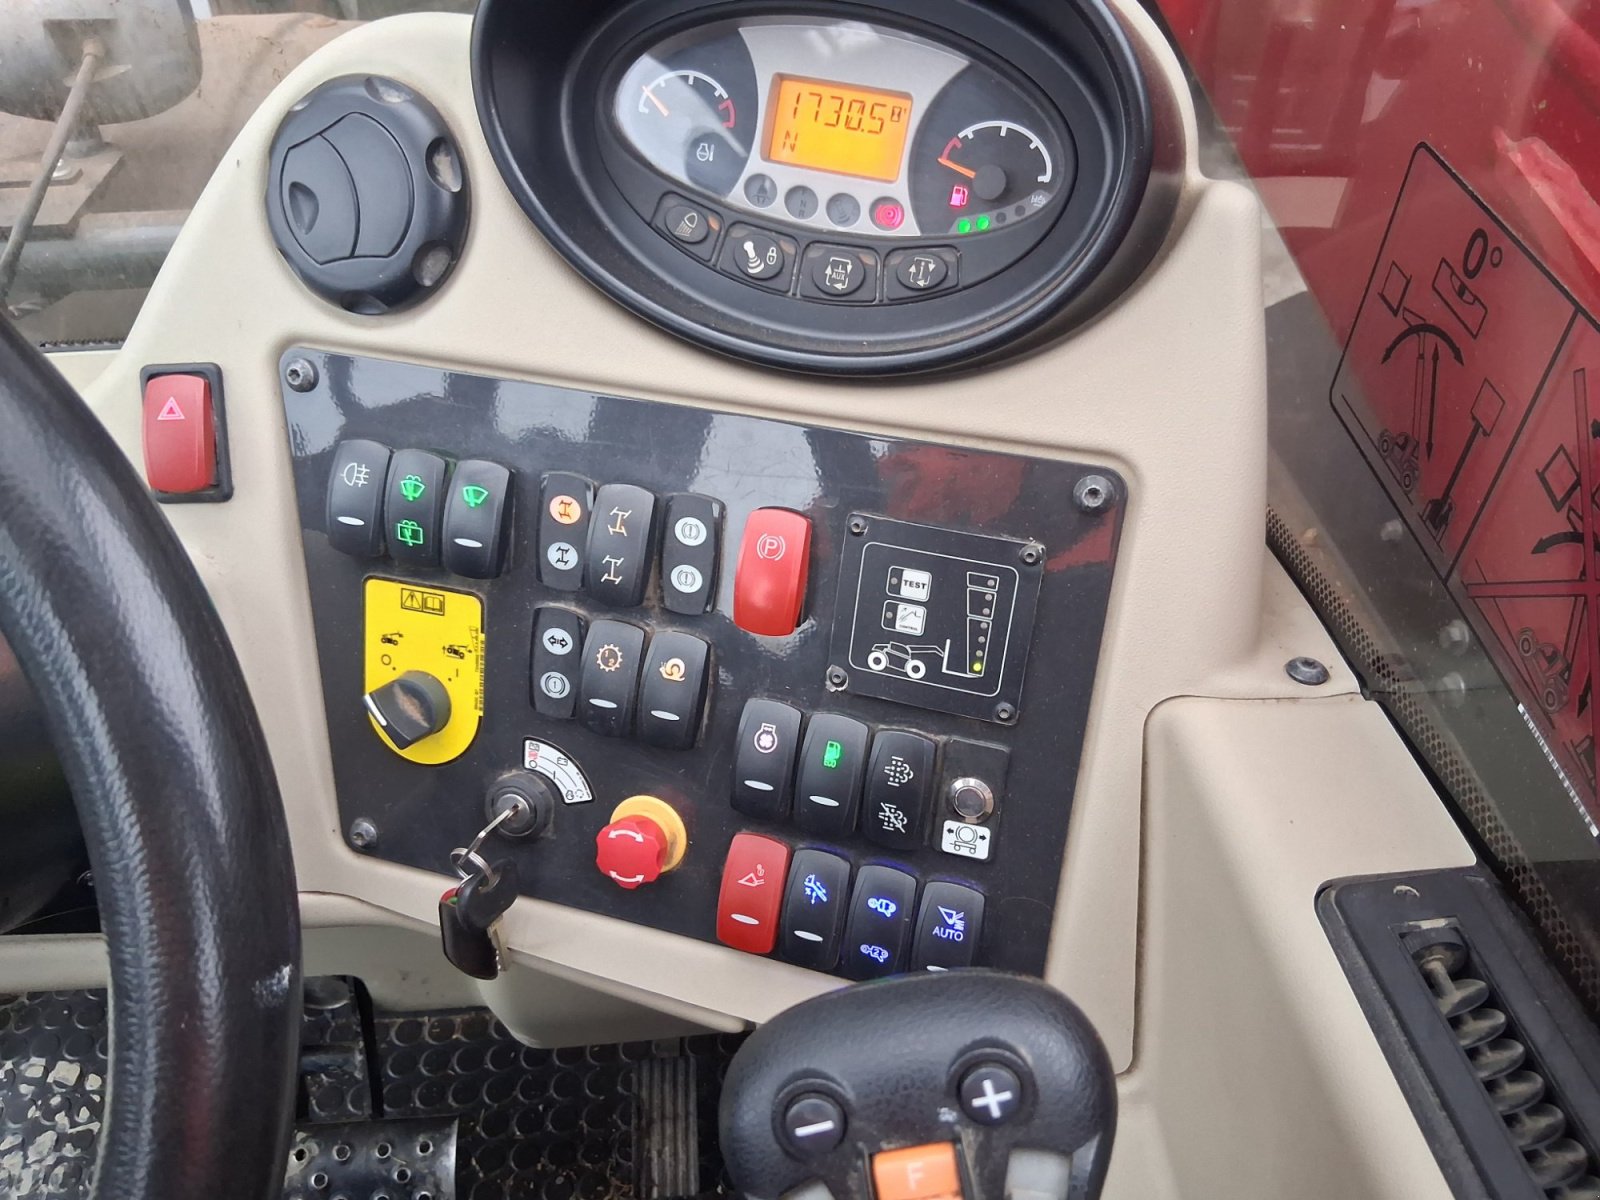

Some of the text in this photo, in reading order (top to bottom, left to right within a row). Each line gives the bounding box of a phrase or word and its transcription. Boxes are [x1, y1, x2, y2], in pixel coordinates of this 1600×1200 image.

[782, 129, 799, 153] N
[831, 270, 846, 282] AUX
[764, 537, 779, 556] P
[903, 579, 928, 590] TEST
[931, 925, 965, 942] AUTO
[906, 1160, 924, 1192] F
